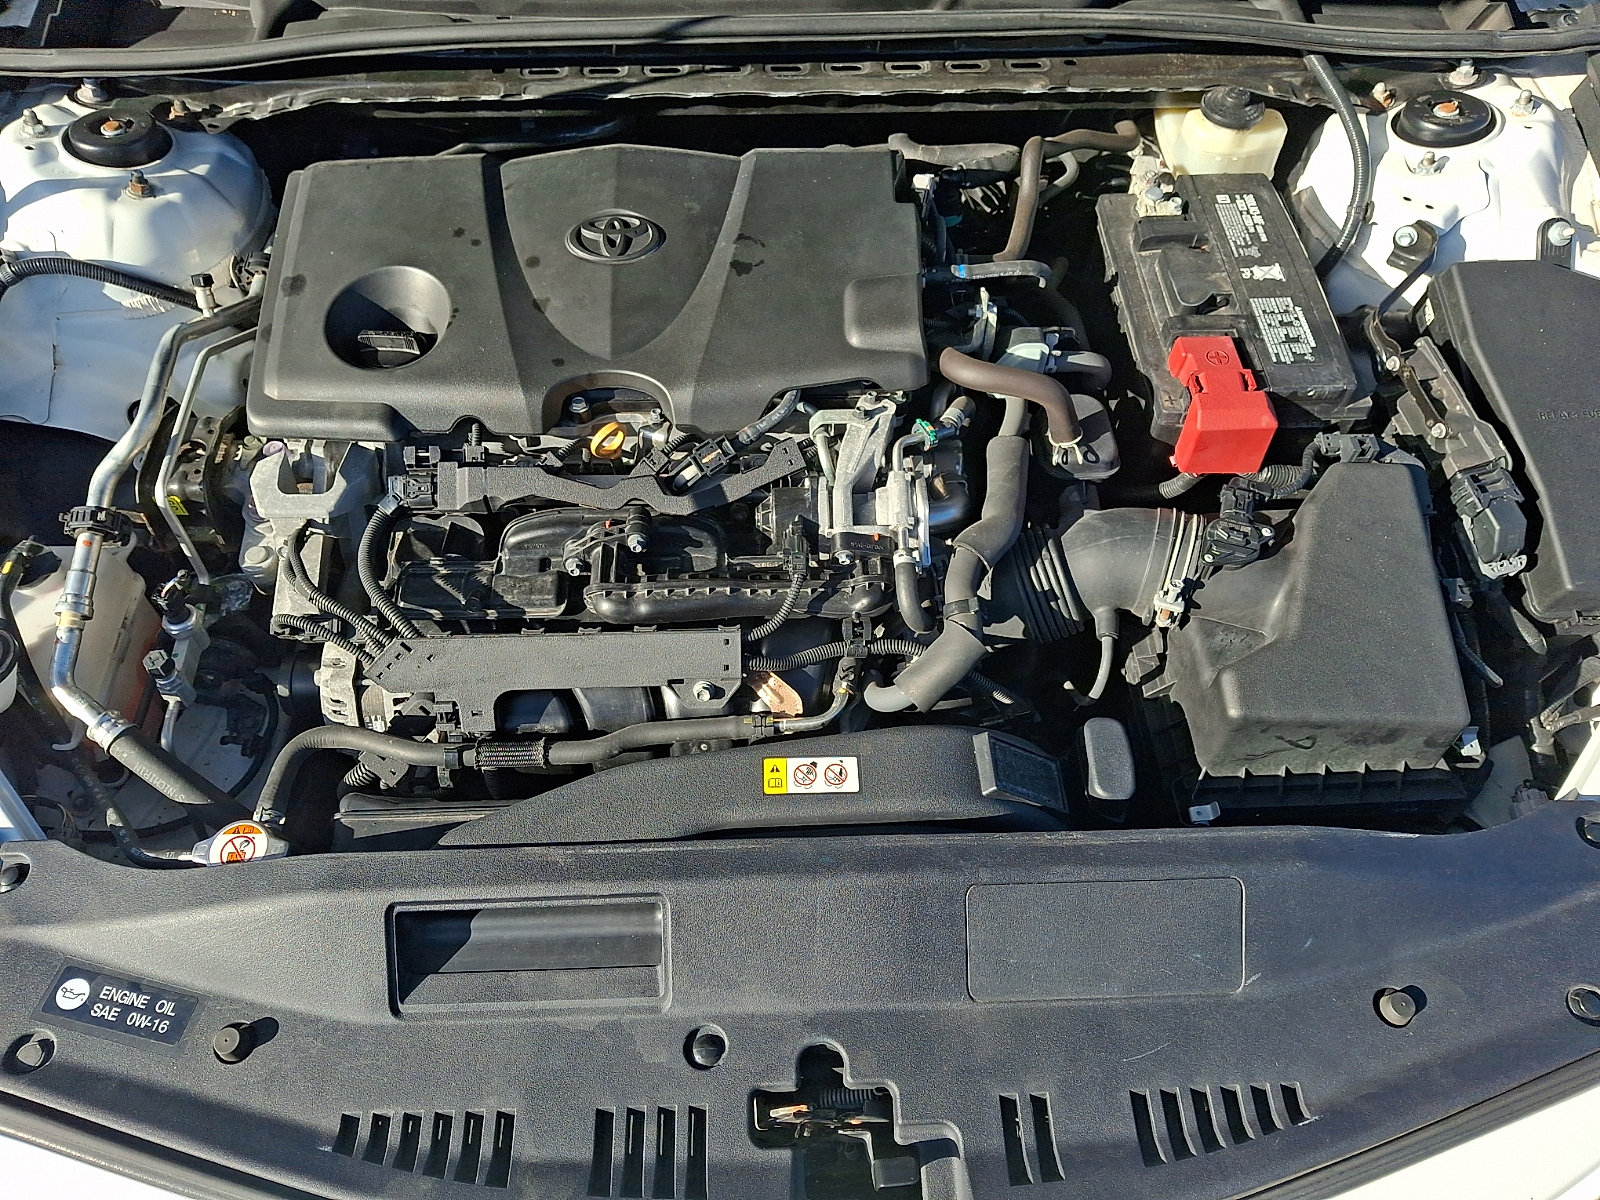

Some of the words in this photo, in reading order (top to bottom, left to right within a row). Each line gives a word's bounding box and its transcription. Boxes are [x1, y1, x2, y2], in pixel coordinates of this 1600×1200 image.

[99, 985, 151, 1009] ENGINE
[155, 999, 176, 1016] OIL
[90, 1003, 121, 1021] SAE
[126, 1012, 170, 1034] 0W-16
